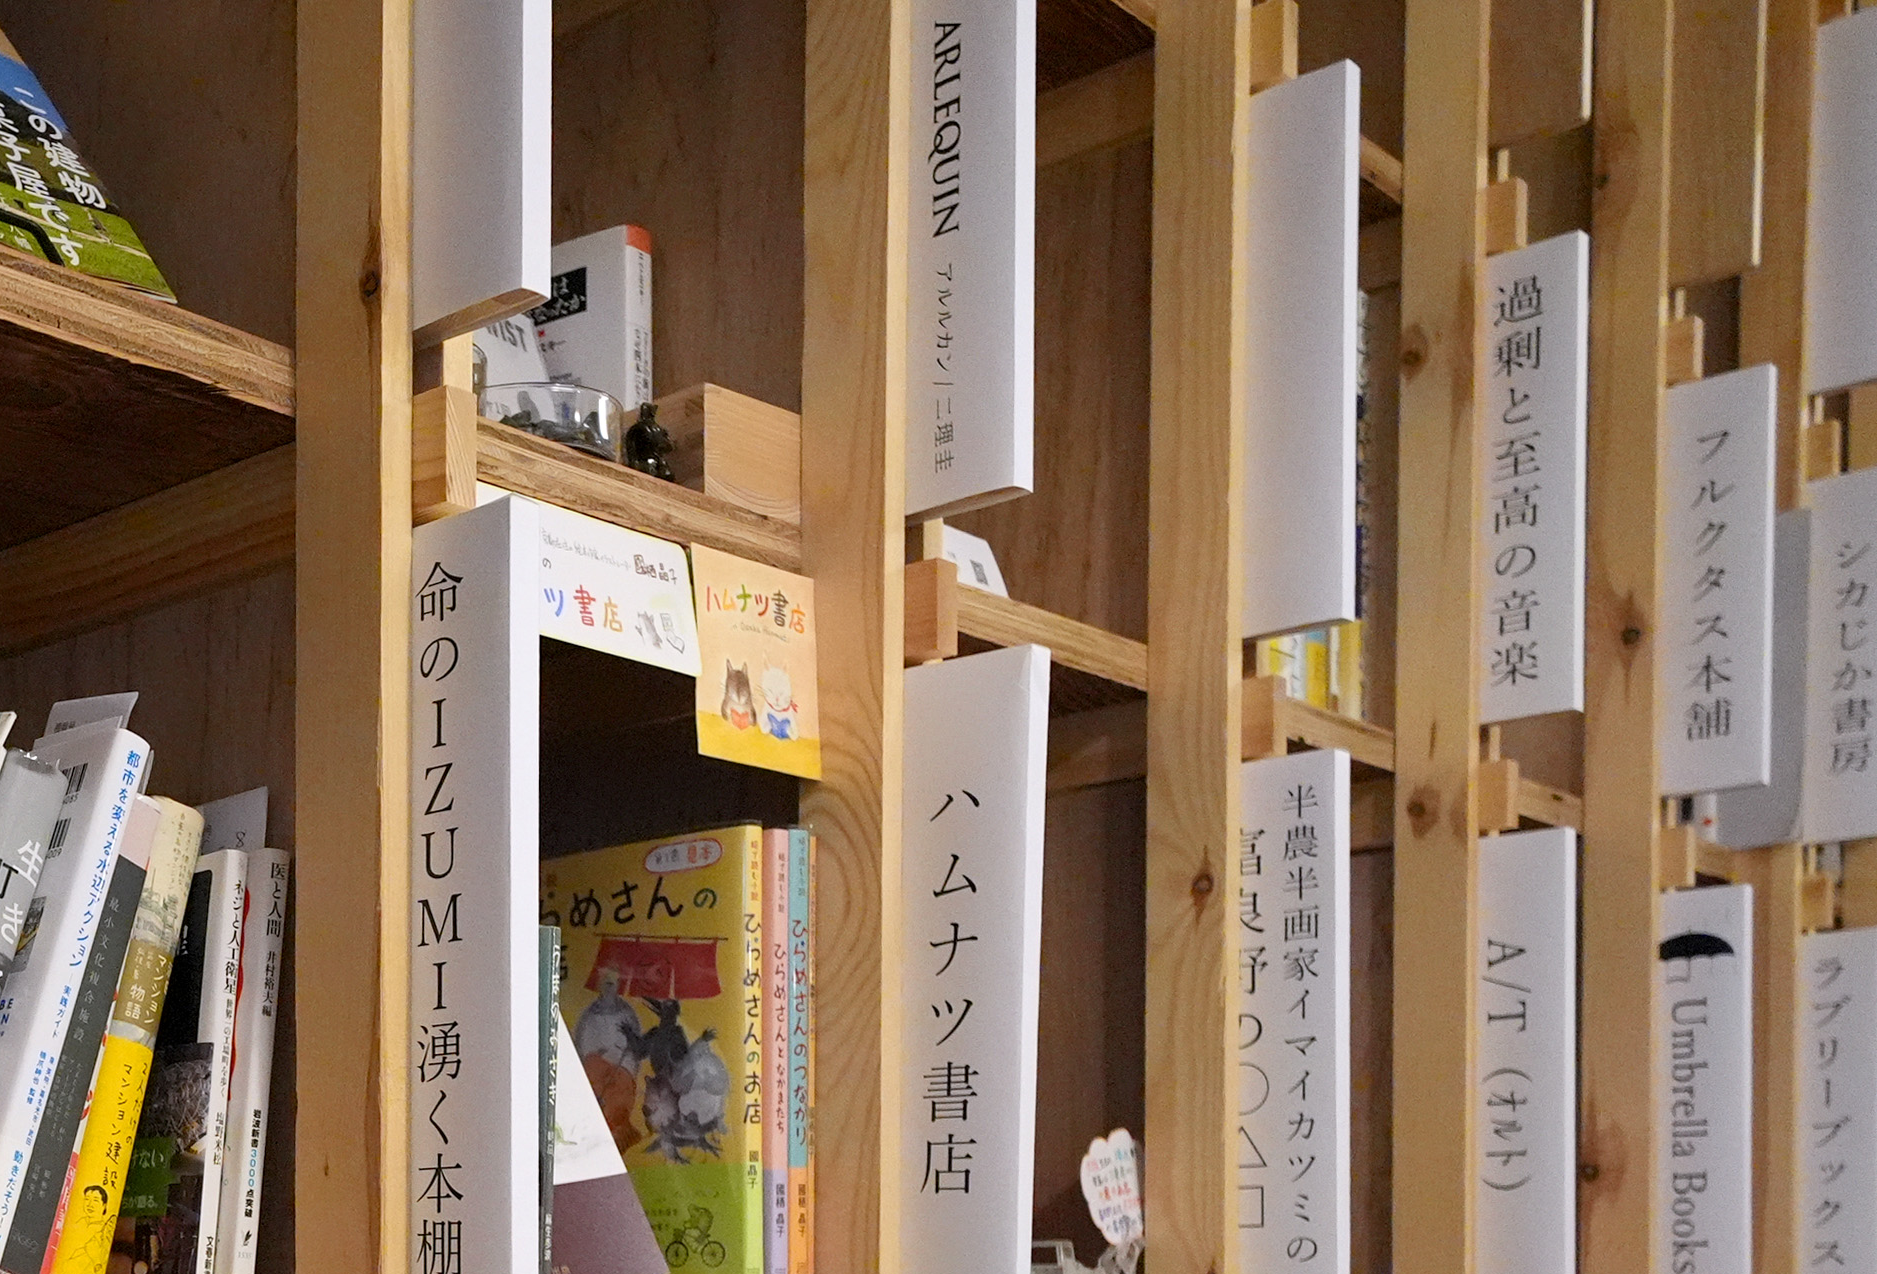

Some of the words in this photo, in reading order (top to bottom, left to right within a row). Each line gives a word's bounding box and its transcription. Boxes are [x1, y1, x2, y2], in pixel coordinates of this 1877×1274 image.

[13, 87, 107, 210] この建物
[928, 21, 962, 239] ARLEQUIN
[1492, 275, 1542, 687] 過剰と至高の音楽
[1687, 430, 1735, 741] フルクタス本舗
[543, 584, 624, 633] ツ書店
[706, 585, 806, 635] ハムナツ書店
[69, 750, 140, 967] 都市を変える水辺アクション
[266, 862, 289, 939] 医と人間
[743, 913, 761, 1124] ひらめさんのお店
[774, 943, 787, 1134] ひらめさんとなかまたち
[792, 919, 808, 1146] ひらめさんのつながり
[920, 787, 981, 1195] ハムナツ書店
[1283, 783, 1319, 1263] 半農半画家イマイカツミの
[1482, 939, 1531, 1033] A/T
[1670, 997, 1708, 1158] Umbrella
